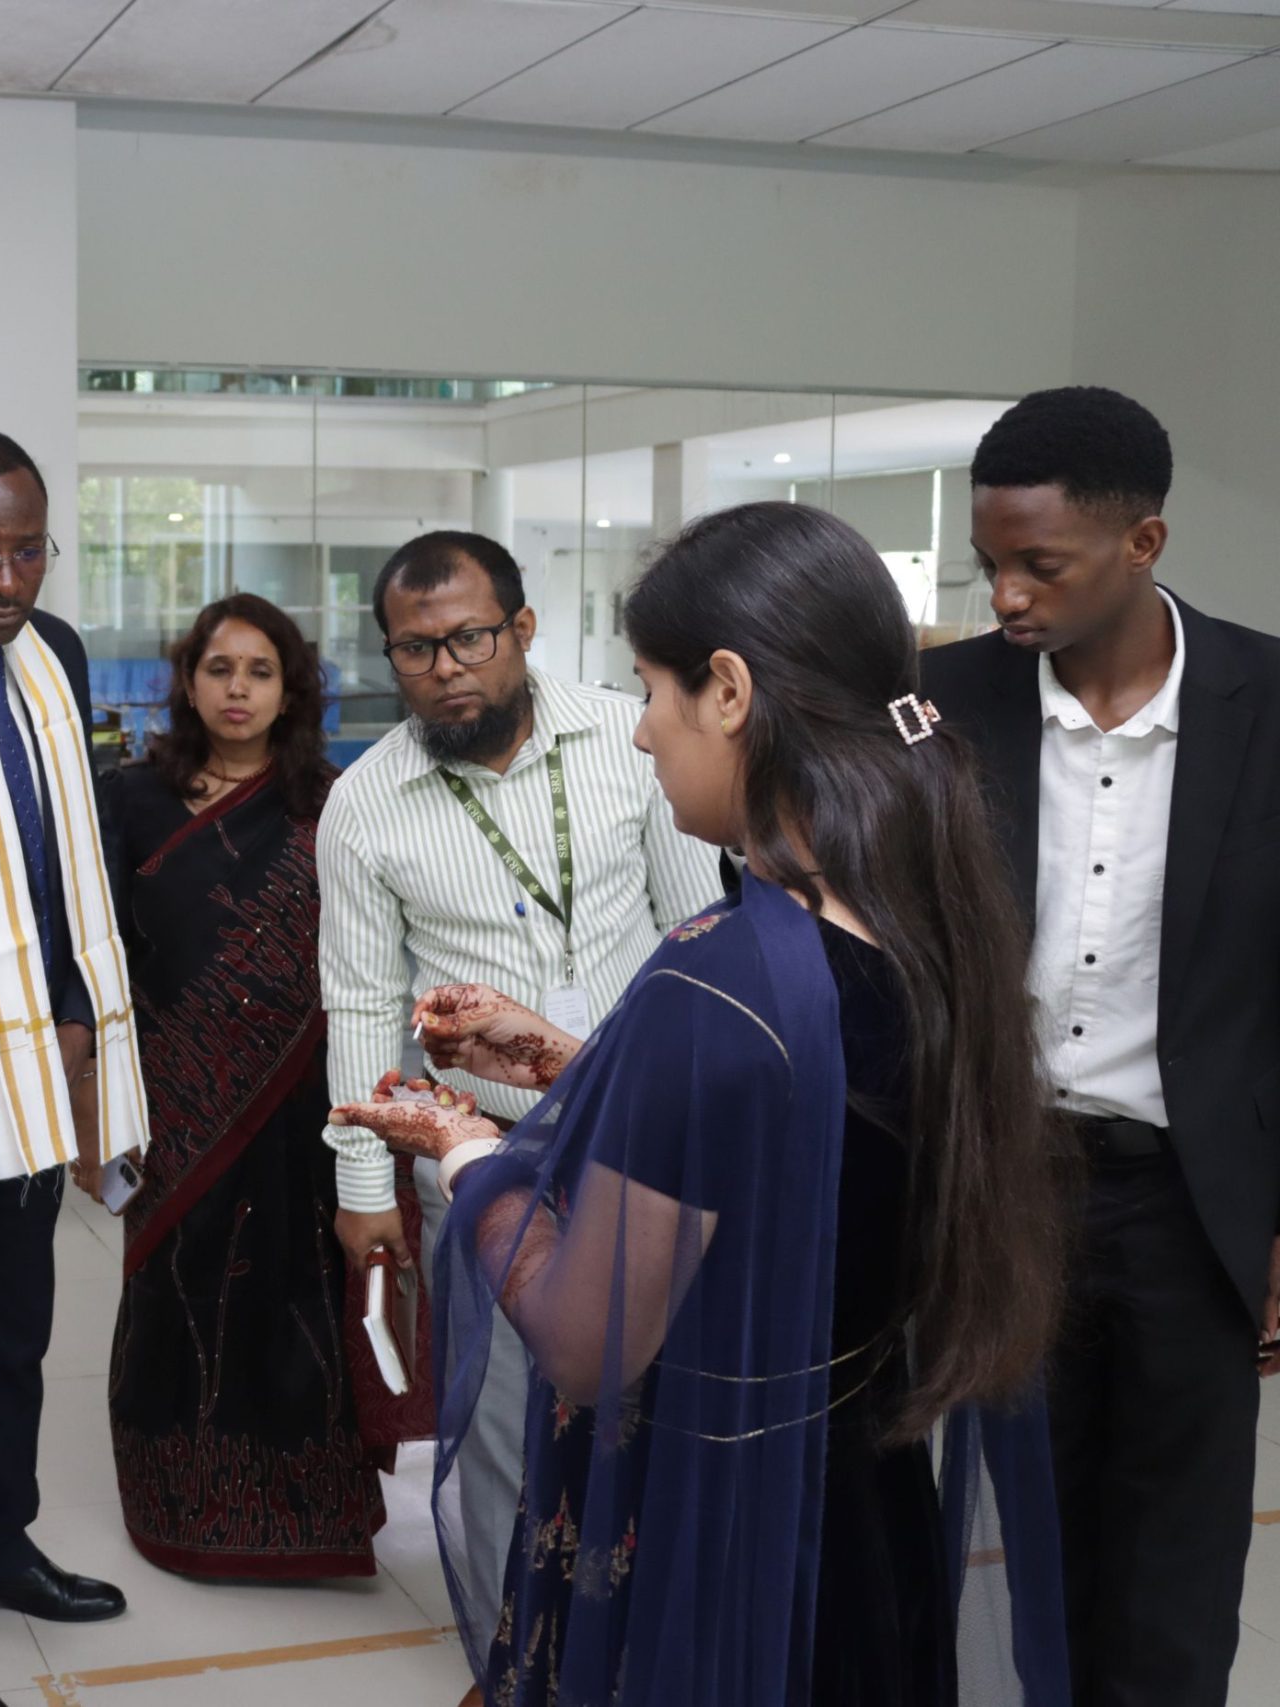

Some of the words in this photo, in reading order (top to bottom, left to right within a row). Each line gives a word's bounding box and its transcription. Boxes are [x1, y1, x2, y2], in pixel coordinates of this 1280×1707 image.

[549, 768, 562, 794] SRM
[463, 800, 483, 824] SRM
[556, 832, 568, 859] SRM
[502, 851, 522, 876] SRM
